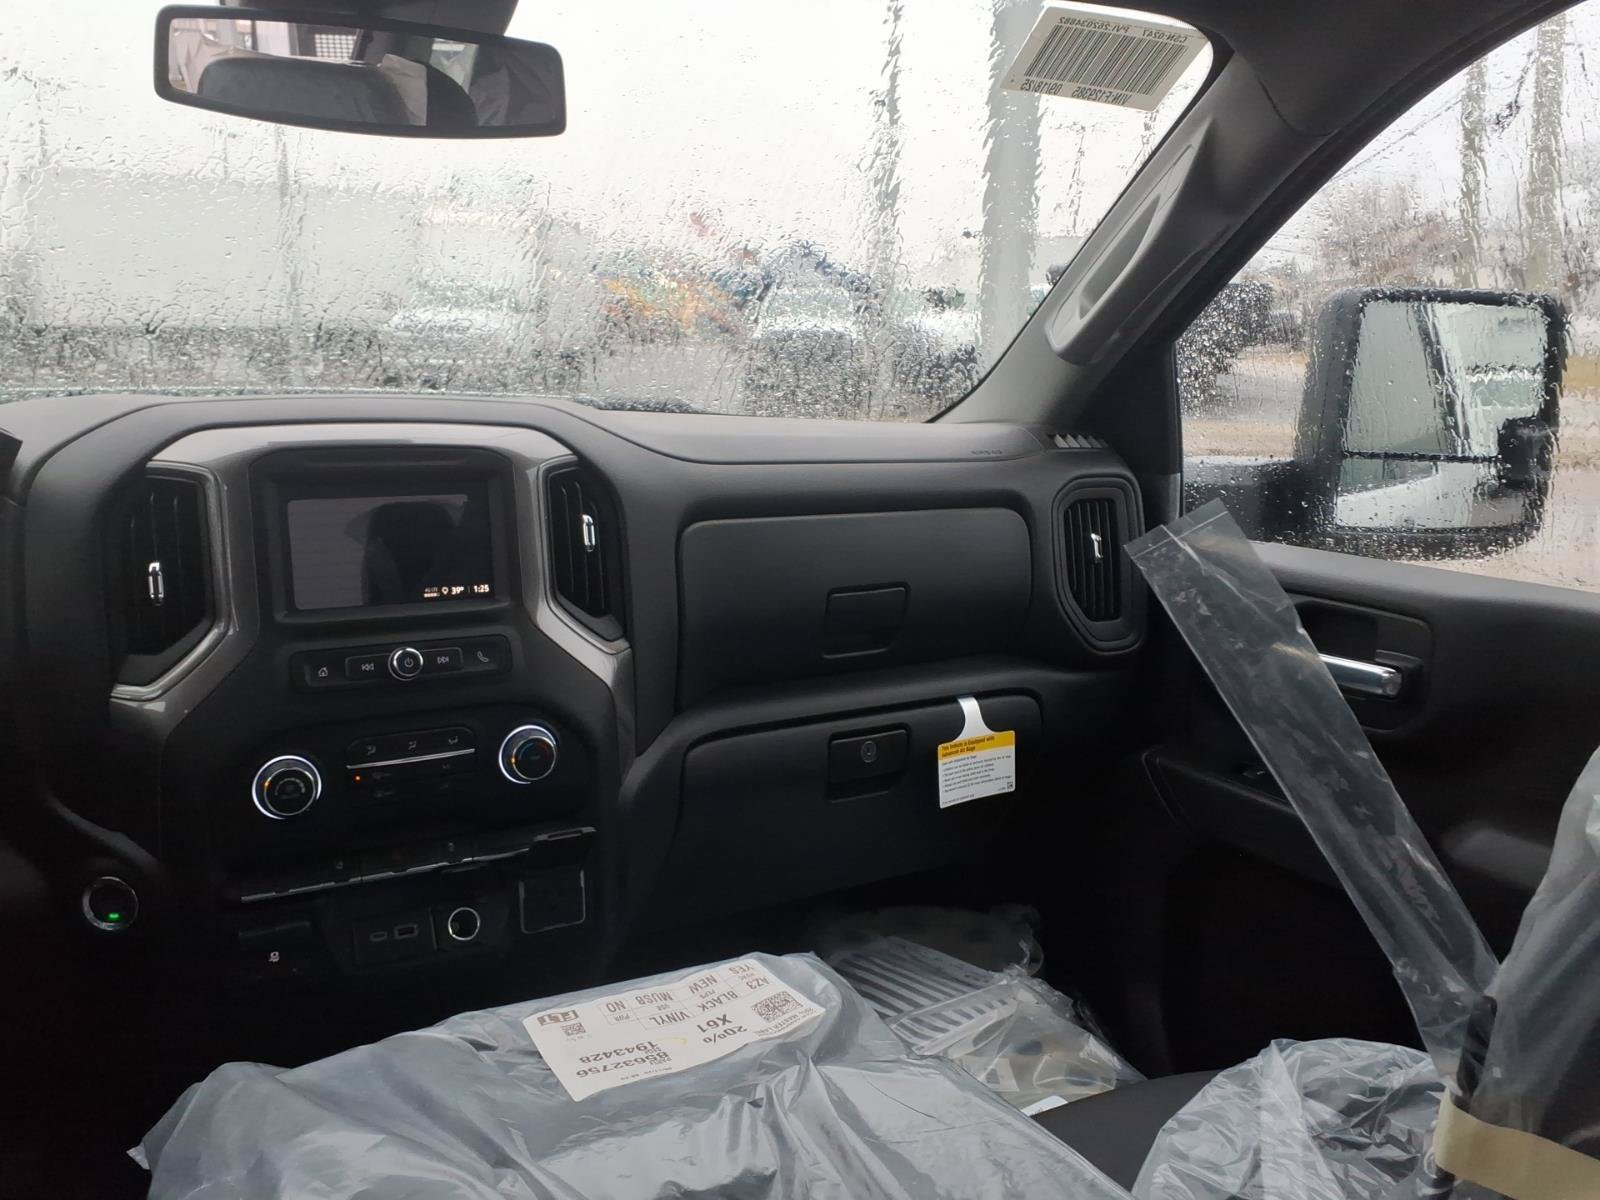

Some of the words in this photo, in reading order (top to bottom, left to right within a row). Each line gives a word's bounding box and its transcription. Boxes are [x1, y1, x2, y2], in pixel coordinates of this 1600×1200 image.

[473, 584, 490, 593] 1:25
[728, 963, 755, 976] YES
[688, 974, 718, 995] NEW
[606, 1000, 627, 1013] NO
[635, 990, 673, 1005] MUSB
[697, 990, 739, 1012] BLACK
[650, 1010, 691, 1026] VINYL
[697, 1013, 733, 1033] X61
[579, 1041, 659, 1064] 1943428
[576, 1051, 670, 1078] 85632756
